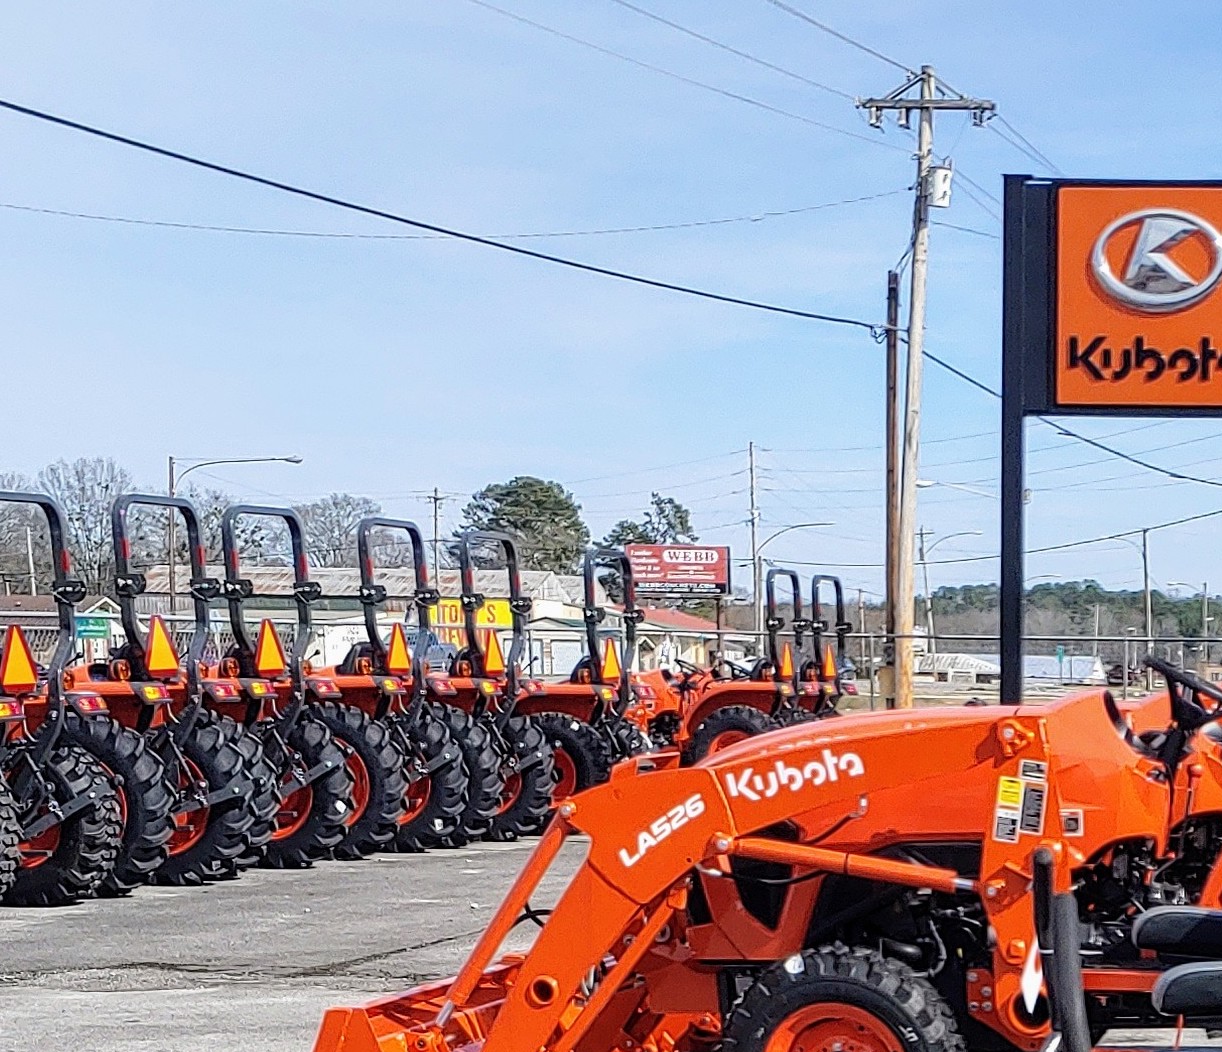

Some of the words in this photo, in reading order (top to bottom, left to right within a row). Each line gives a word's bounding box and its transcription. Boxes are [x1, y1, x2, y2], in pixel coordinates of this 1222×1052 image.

[668, 551, 714, 562] WEBB
[724, 749, 865, 801] Kubota
[618, 793, 706, 867] LA526
